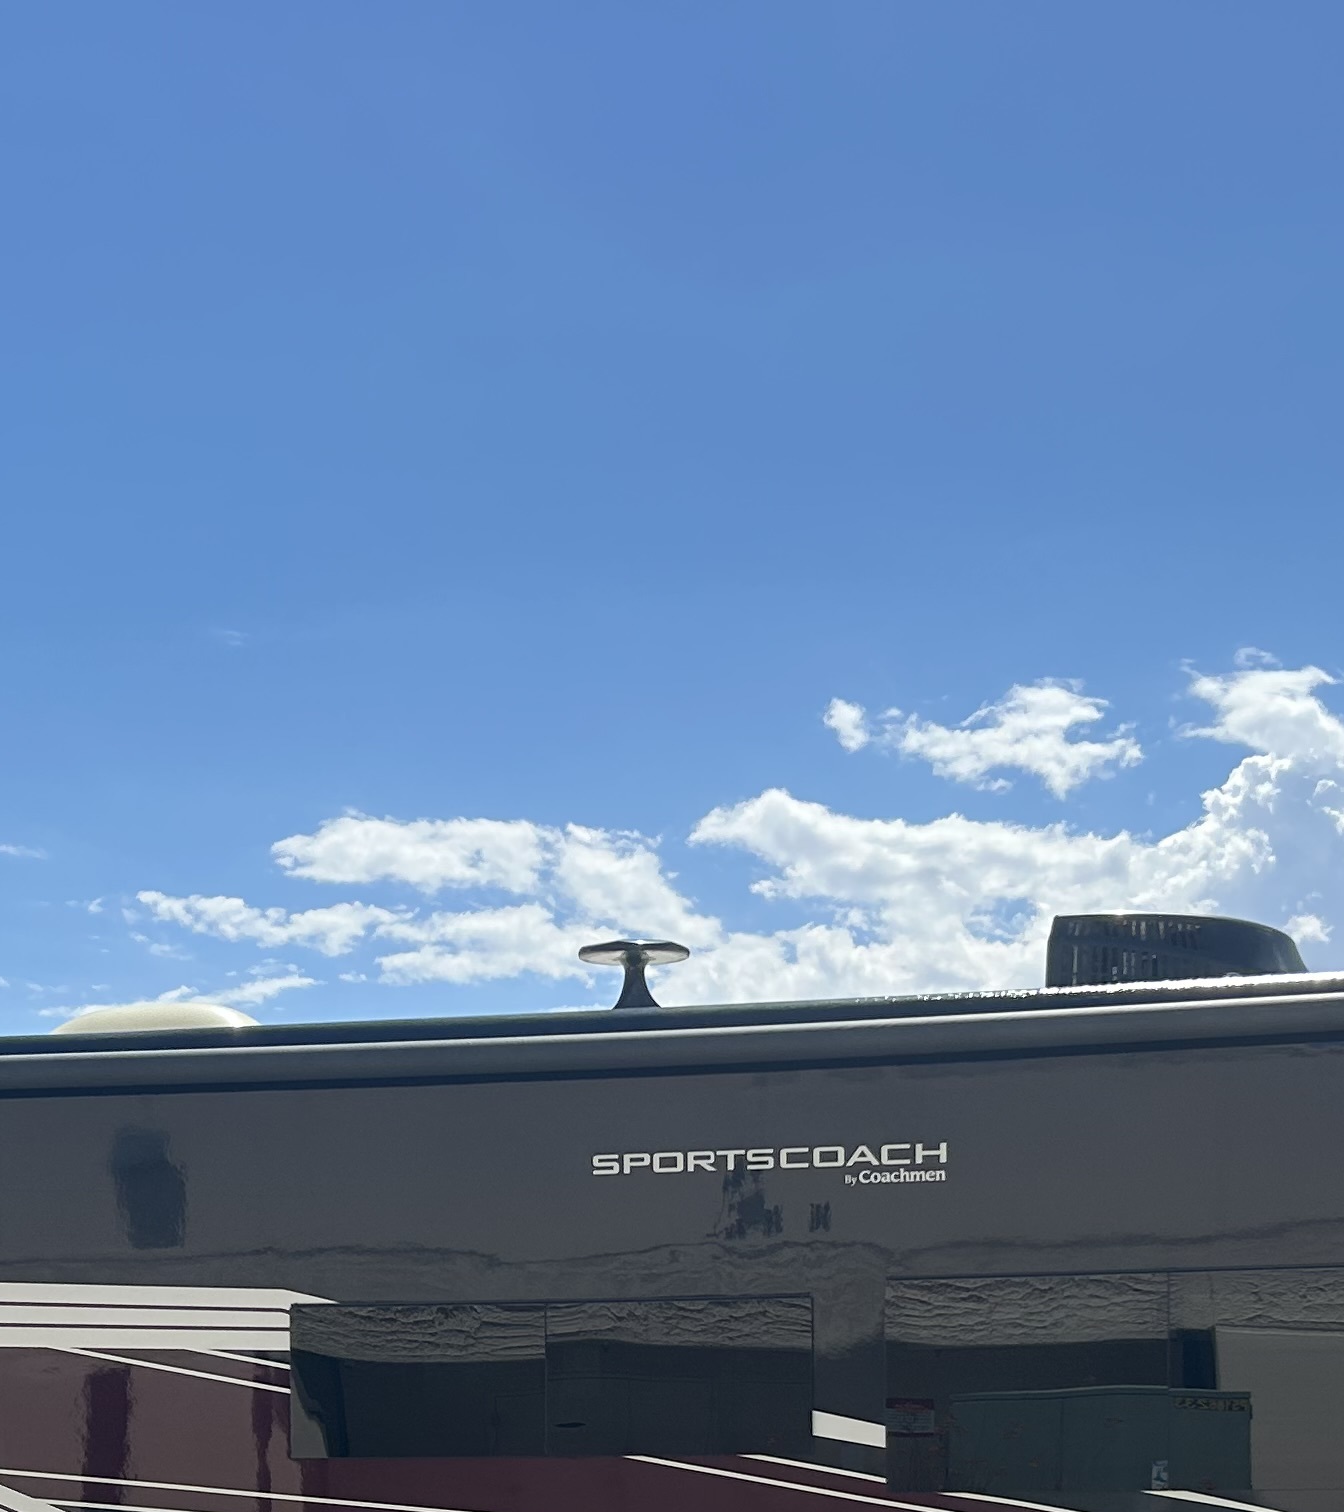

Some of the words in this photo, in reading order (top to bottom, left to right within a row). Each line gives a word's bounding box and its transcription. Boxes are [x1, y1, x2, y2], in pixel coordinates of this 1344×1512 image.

[592, 1142, 948, 1175] SPORTSCOACH
[844, 1174, 858, 1187] By
[858, 1168, 946, 1184] Coachmen
